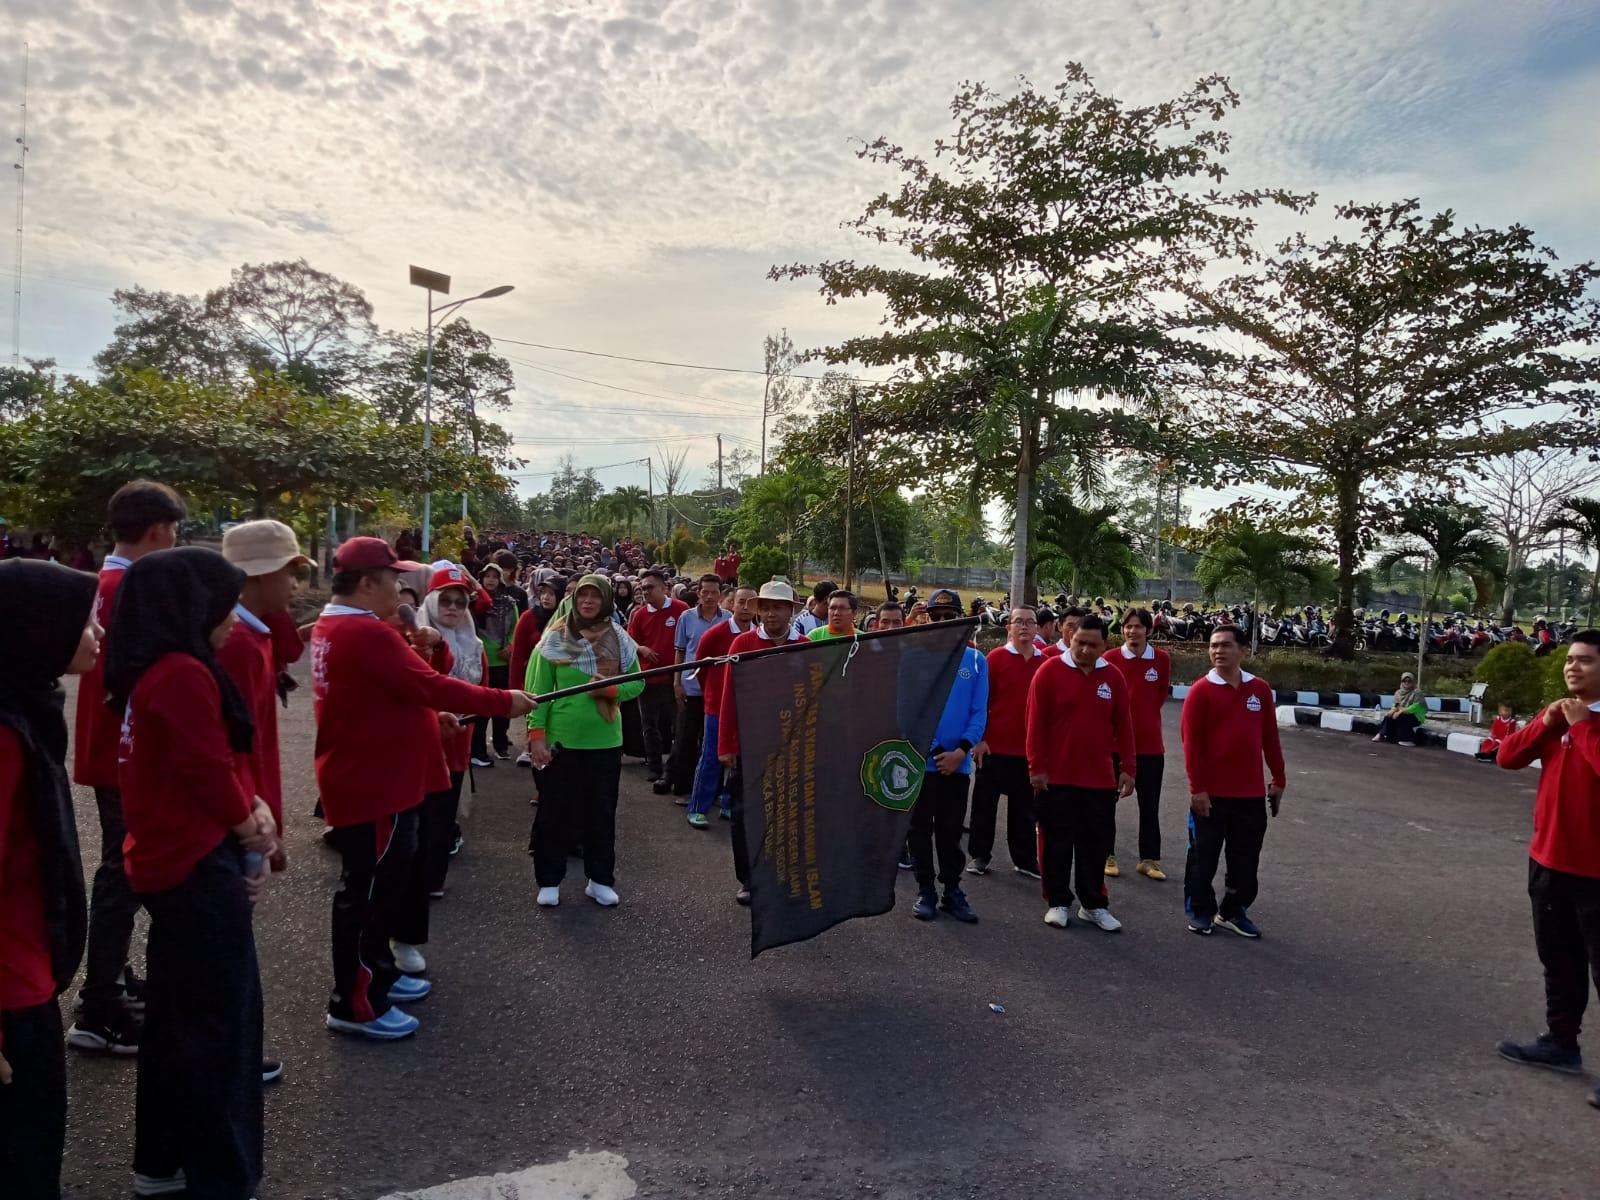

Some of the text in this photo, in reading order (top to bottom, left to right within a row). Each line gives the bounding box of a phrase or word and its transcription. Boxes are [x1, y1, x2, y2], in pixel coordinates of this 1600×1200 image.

[788, 781, 799, 818] ISLAM
[804, 781, 815, 806] DAN
[788, 820, 798, 864] NEGERI
[806, 868, 822, 909] ISLAM
